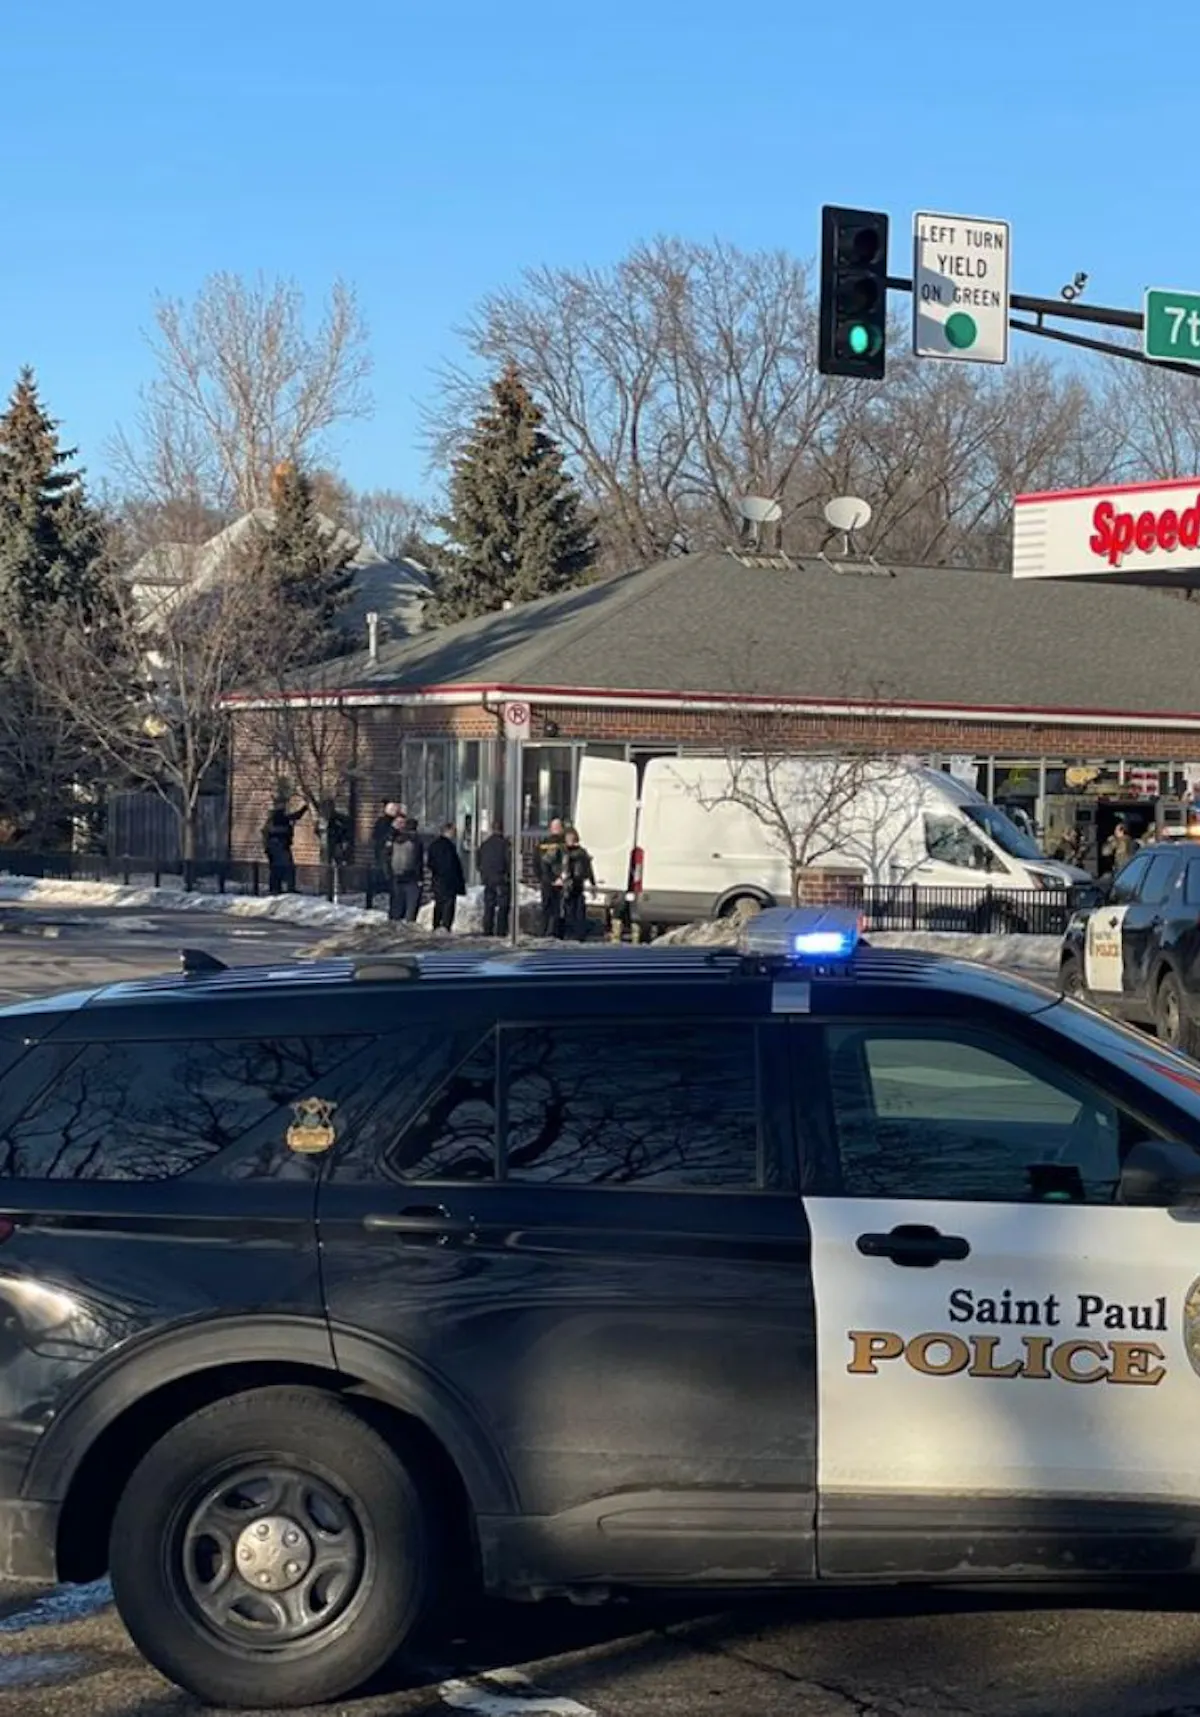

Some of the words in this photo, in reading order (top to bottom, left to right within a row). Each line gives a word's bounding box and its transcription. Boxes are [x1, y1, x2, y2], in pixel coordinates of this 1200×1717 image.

[920, 225, 956, 244] LEFT
[966, 229, 1004, 249] TURN
[937, 254, 987, 278] YIELD
[921, 284, 942, 304] ON
[952, 286, 1000, 307] GREEN
[949, 1288, 1061, 1325] Saint
[1075, 1294, 1168, 1331] Paul
[846, 1330, 1166, 1386] POLICE
